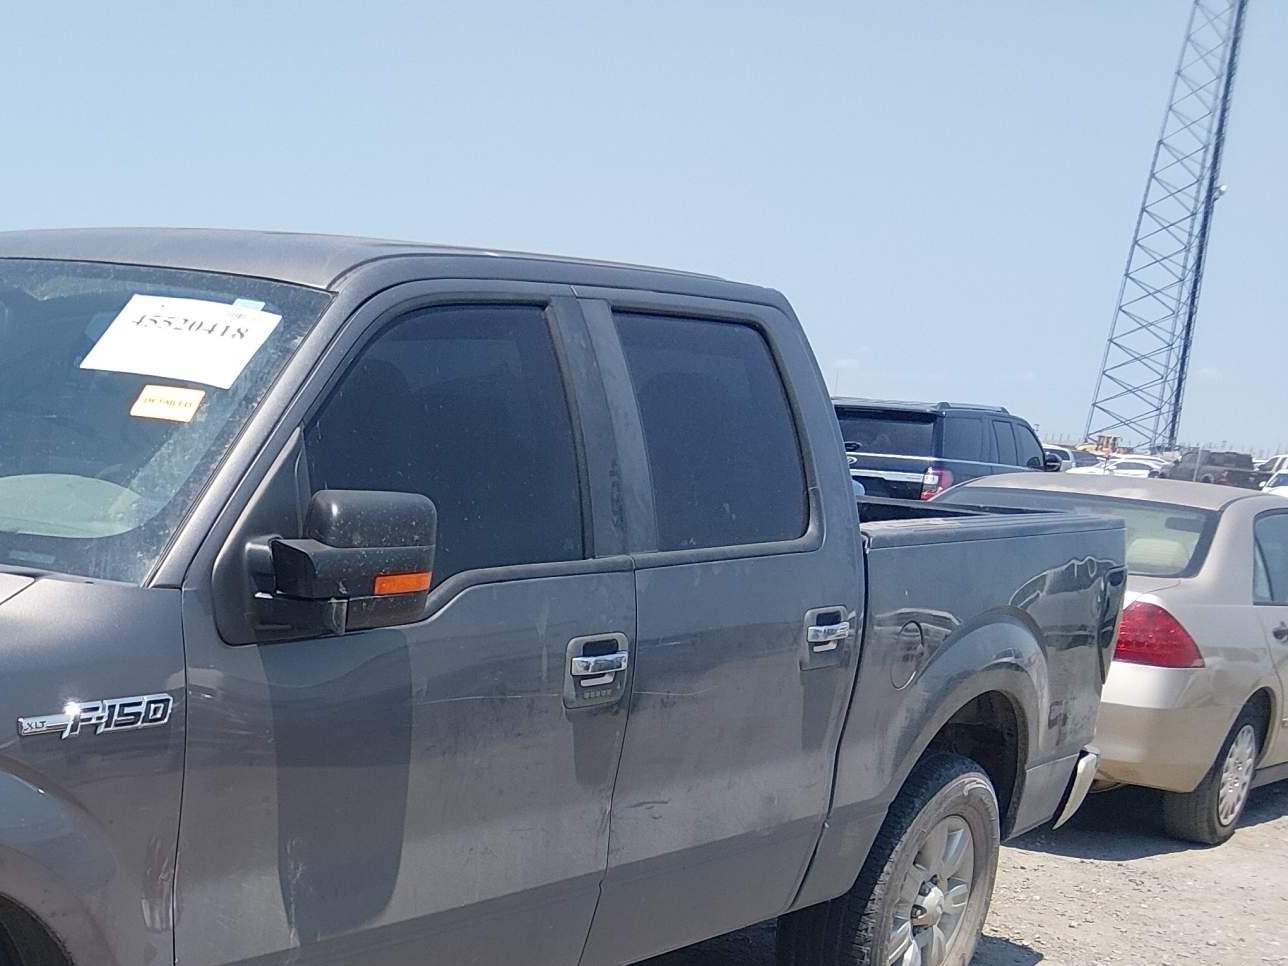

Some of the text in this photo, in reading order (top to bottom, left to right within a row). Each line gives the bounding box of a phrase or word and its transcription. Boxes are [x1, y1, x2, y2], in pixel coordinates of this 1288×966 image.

[131, 314, 248, 340] 45520418
[25, 693, 173, 738] XLT F-150
